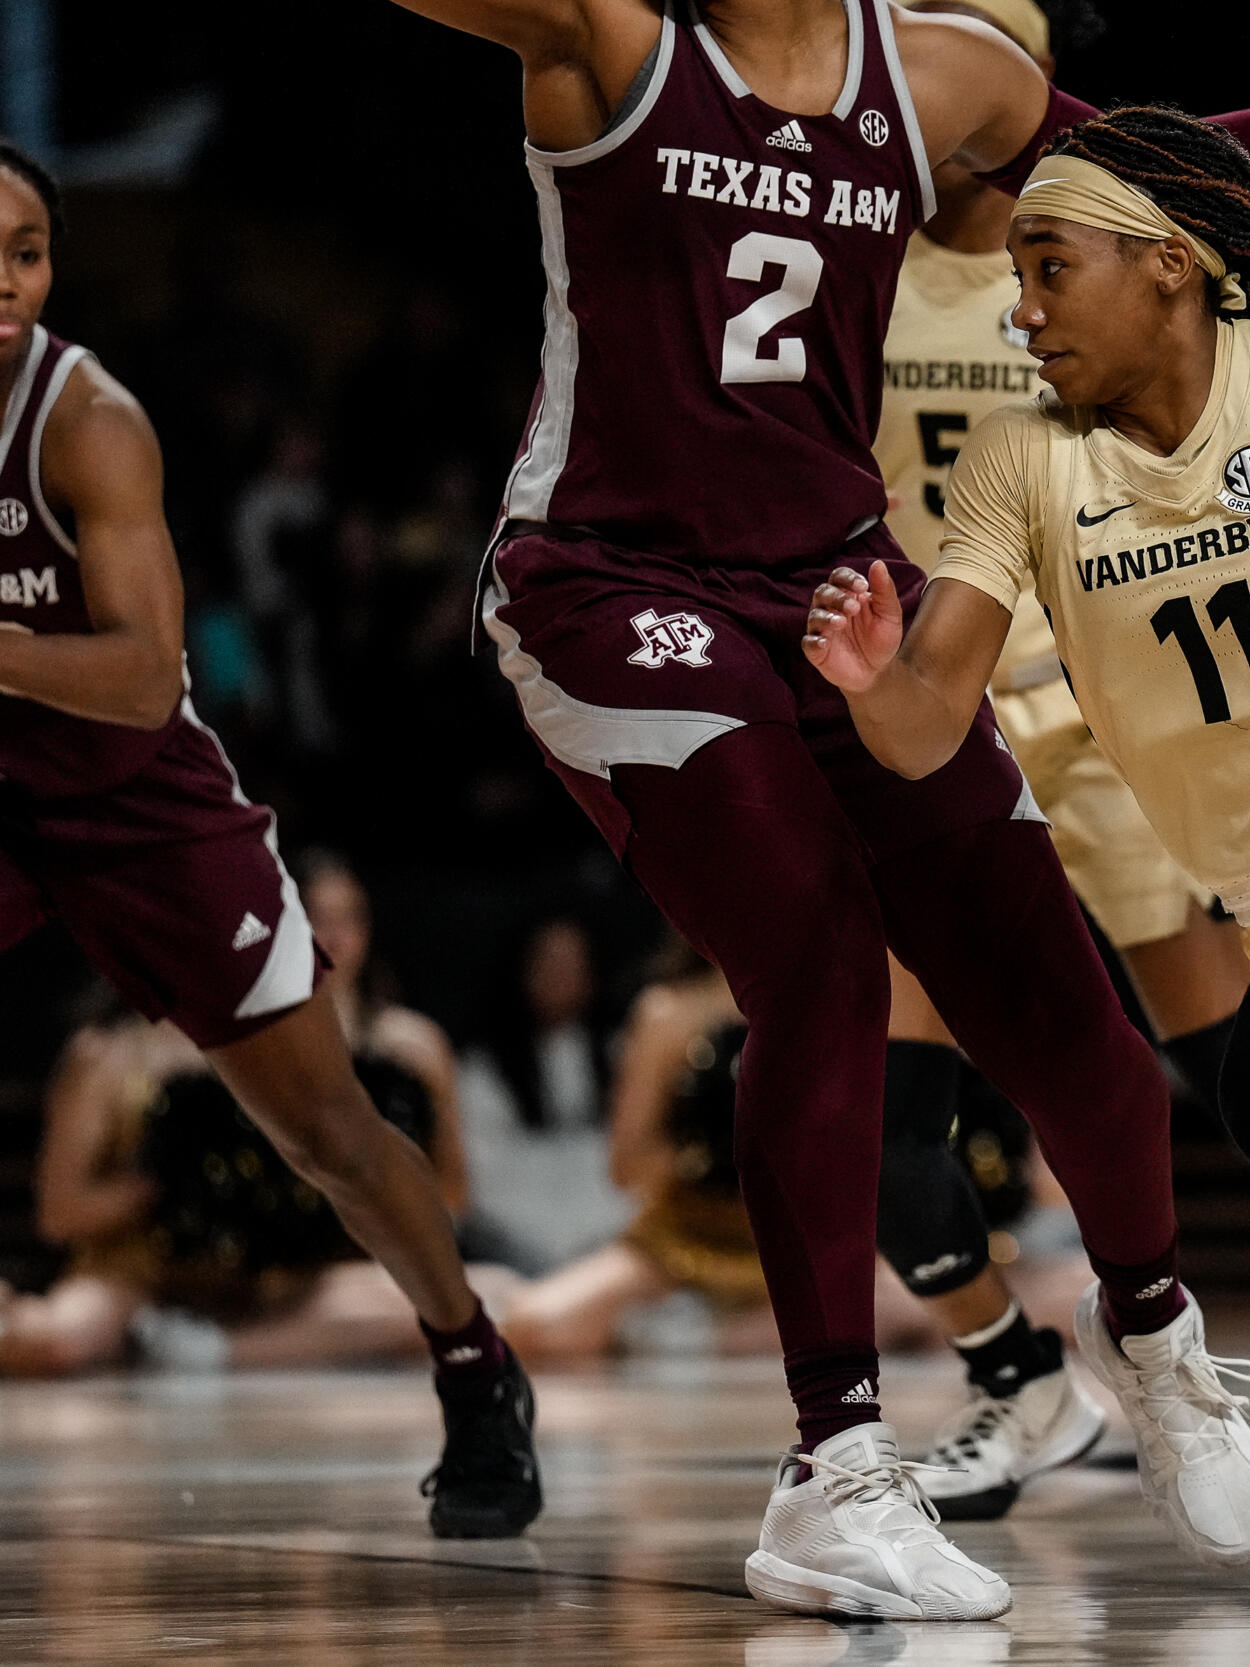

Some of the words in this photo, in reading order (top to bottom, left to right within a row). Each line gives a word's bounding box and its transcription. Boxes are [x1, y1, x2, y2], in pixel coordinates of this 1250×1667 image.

[766, 134, 812, 153] adidas
[861, 112, 888, 145] SEC
[657, 147, 812, 217] TEXAS
[823, 180, 900, 235] A&M
[720, 231, 824, 384] 2
[917, 411, 968, 521] 5
